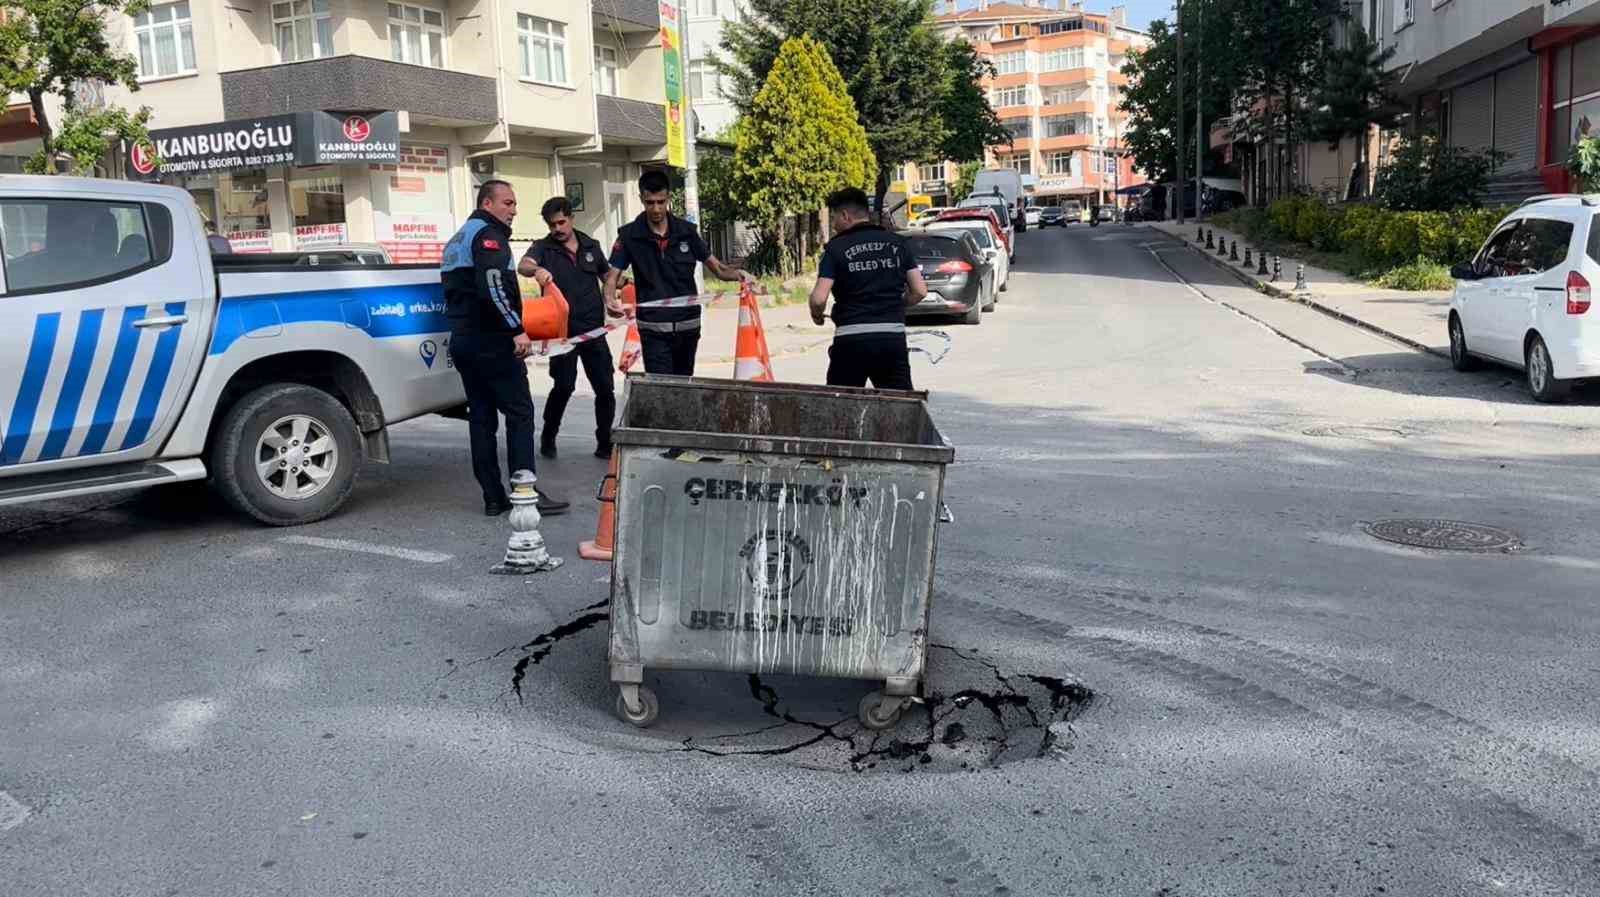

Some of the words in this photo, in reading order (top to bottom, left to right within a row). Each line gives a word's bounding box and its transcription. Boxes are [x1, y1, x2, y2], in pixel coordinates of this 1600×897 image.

[157, 122, 293, 159] KANBUROĞLU
[319, 141, 397, 152] KANBUROĞLU
[320, 152, 357, 160] OTOMOTİV
[366, 152, 396, 160] SİGORTA
[160, 159, 200, 173] OTOMOTİV
[208, 155, 243, 170] SİGORTA
[296, 224, 344, 236] MAPFRE
[393, 223, 438, 233] MAPFRE
